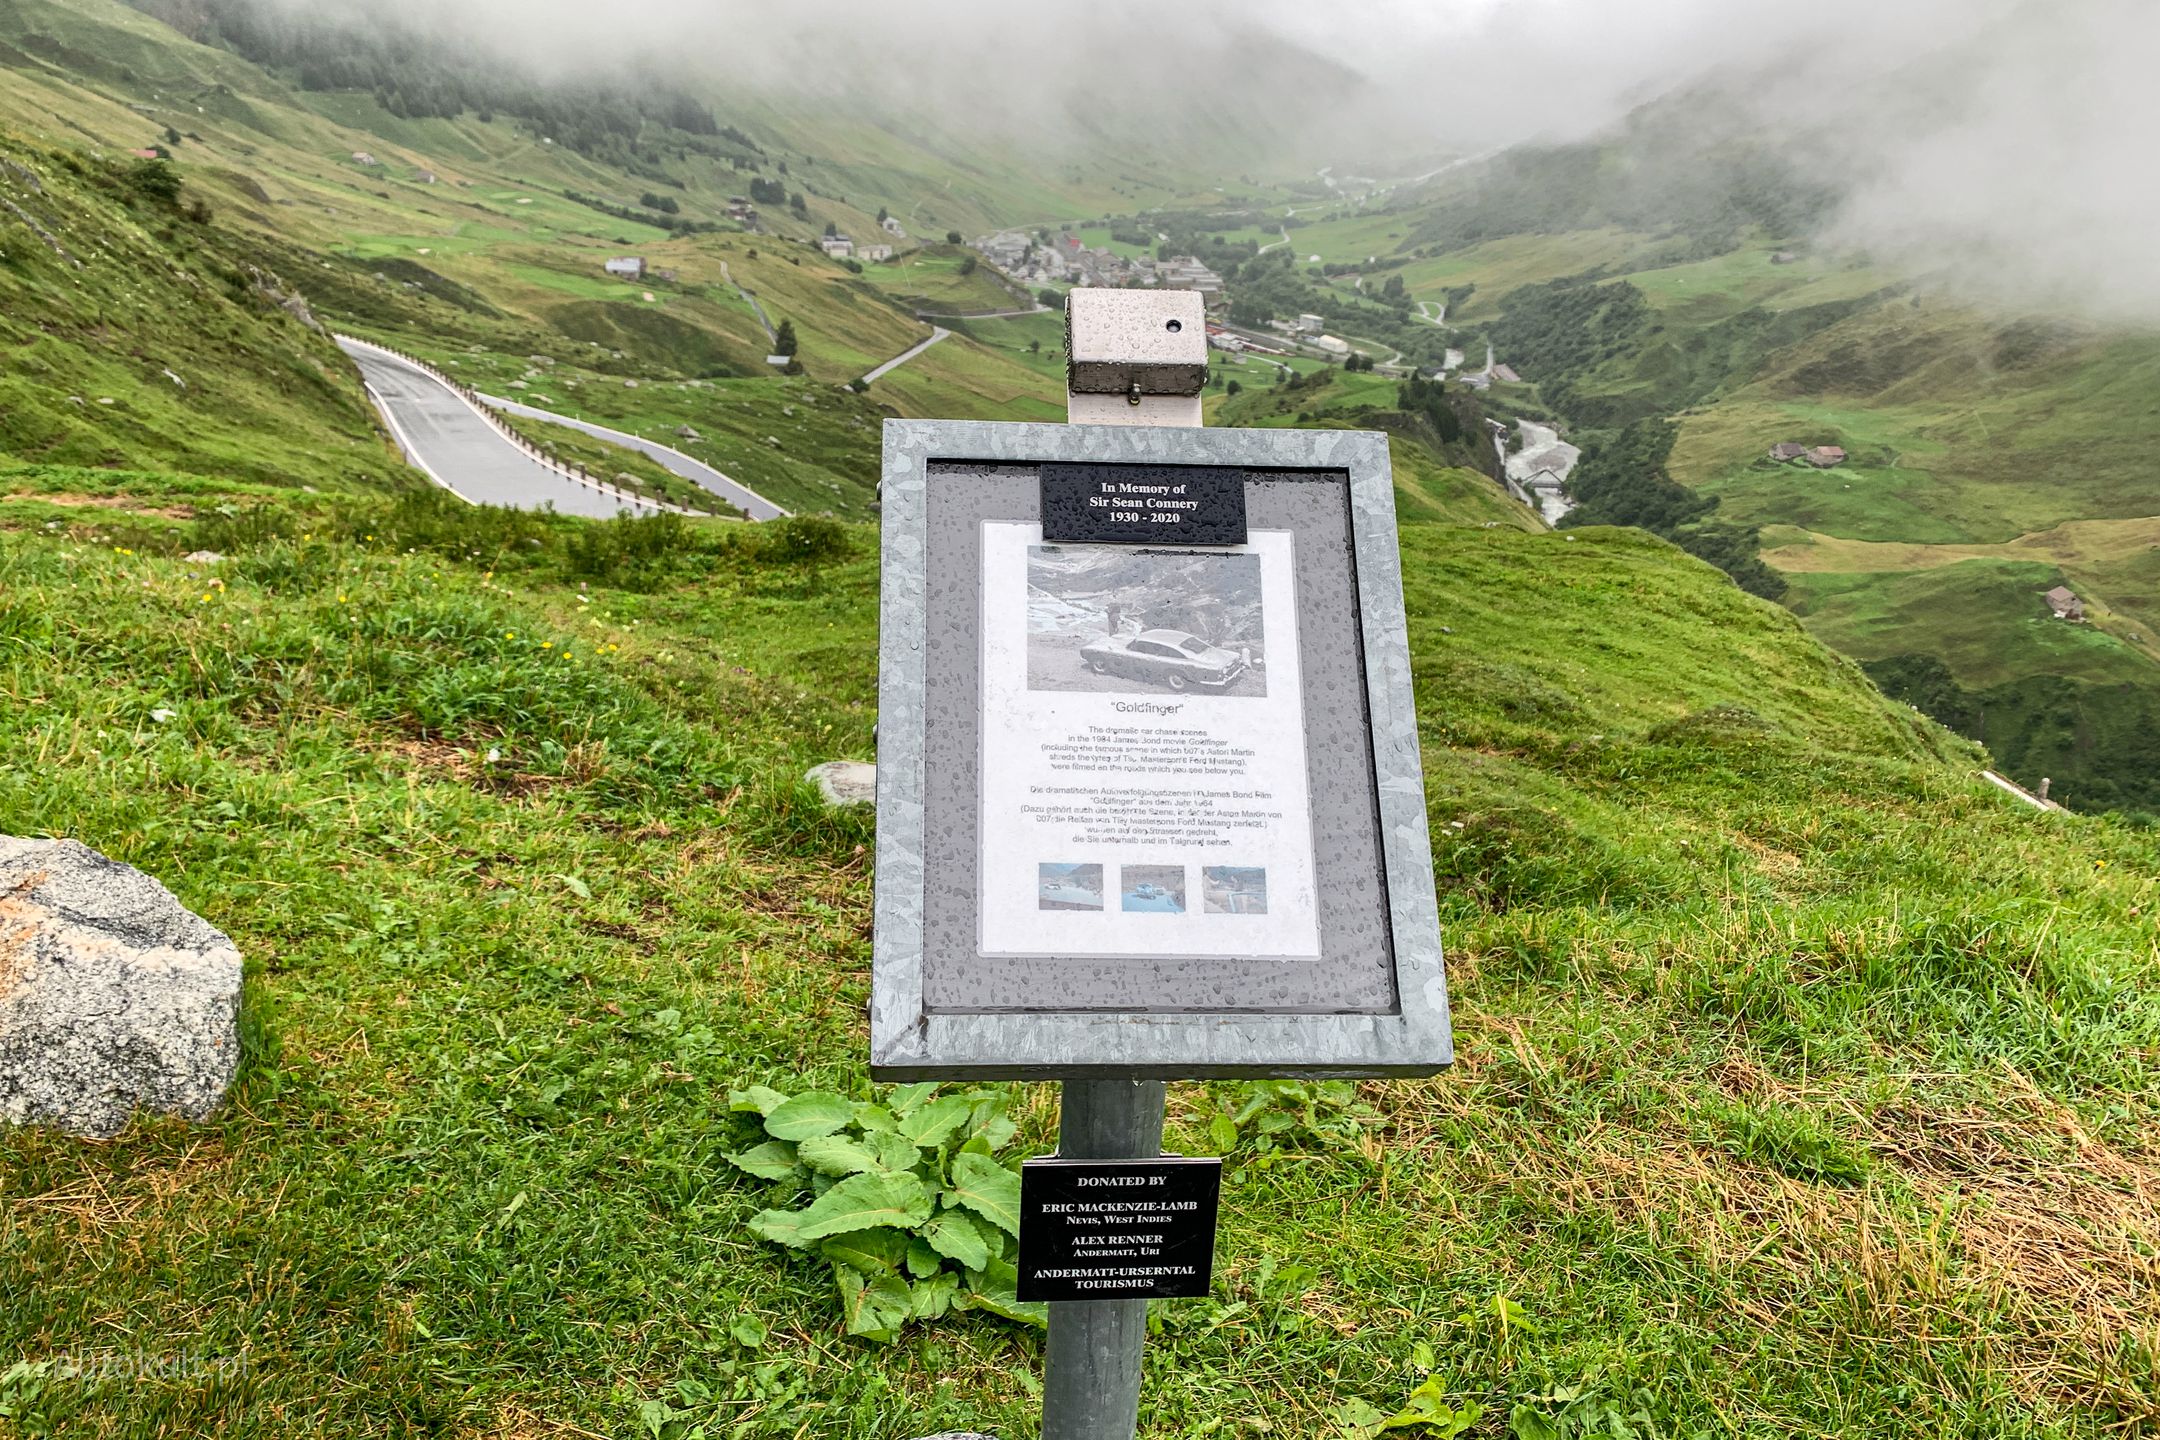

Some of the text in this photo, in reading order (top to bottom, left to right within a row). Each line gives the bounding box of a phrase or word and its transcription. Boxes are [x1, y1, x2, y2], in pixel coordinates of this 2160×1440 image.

[1101, 482, 1186, 495] In Memory of
[1089, 496, 1198, 510] Sir Sean Connery
[1109, 511, 1139, 522] 1930
[1150, 512, 1180, 523] 2020
[1155, 728, 1178, 736] chase
[1163, 737, 1186, 745] movie
[1150, 746, 1159, 754] in
[1160, 746, 1182, 755] which
[1231, 748, 1255, 757] Martin
[1072, 763, 1096, 771] filmed
[1109, 764, 1122, 772] the
[1204, 767, 1228, 775] below
[1232, 790, 1253, 799] Bond
[1174, 799, 1191, 807] Jahr
[1020, 805, 1045, 814] (Dazu
[1177, 817, 1196, 826] Ford
[1072, 835, 1084, 843] die
[1087, 835, 1100, 844] Sie
[1140, 836, 1156, 844] und
[1157, 837, 1168, 845] im
[1077, 1175, 1167, 1187] DONATED BY
[1042, 1201, 1198, 1213] ERIC MACKENZIE-LAMB
[1071, 1234, 1163, 1246] ALEX RENNER
[1034, 1265, 1196, 1279] ANDERMATT-URSERNTAL
[1075, 1278, 1154, 1289] TOURISMUS
